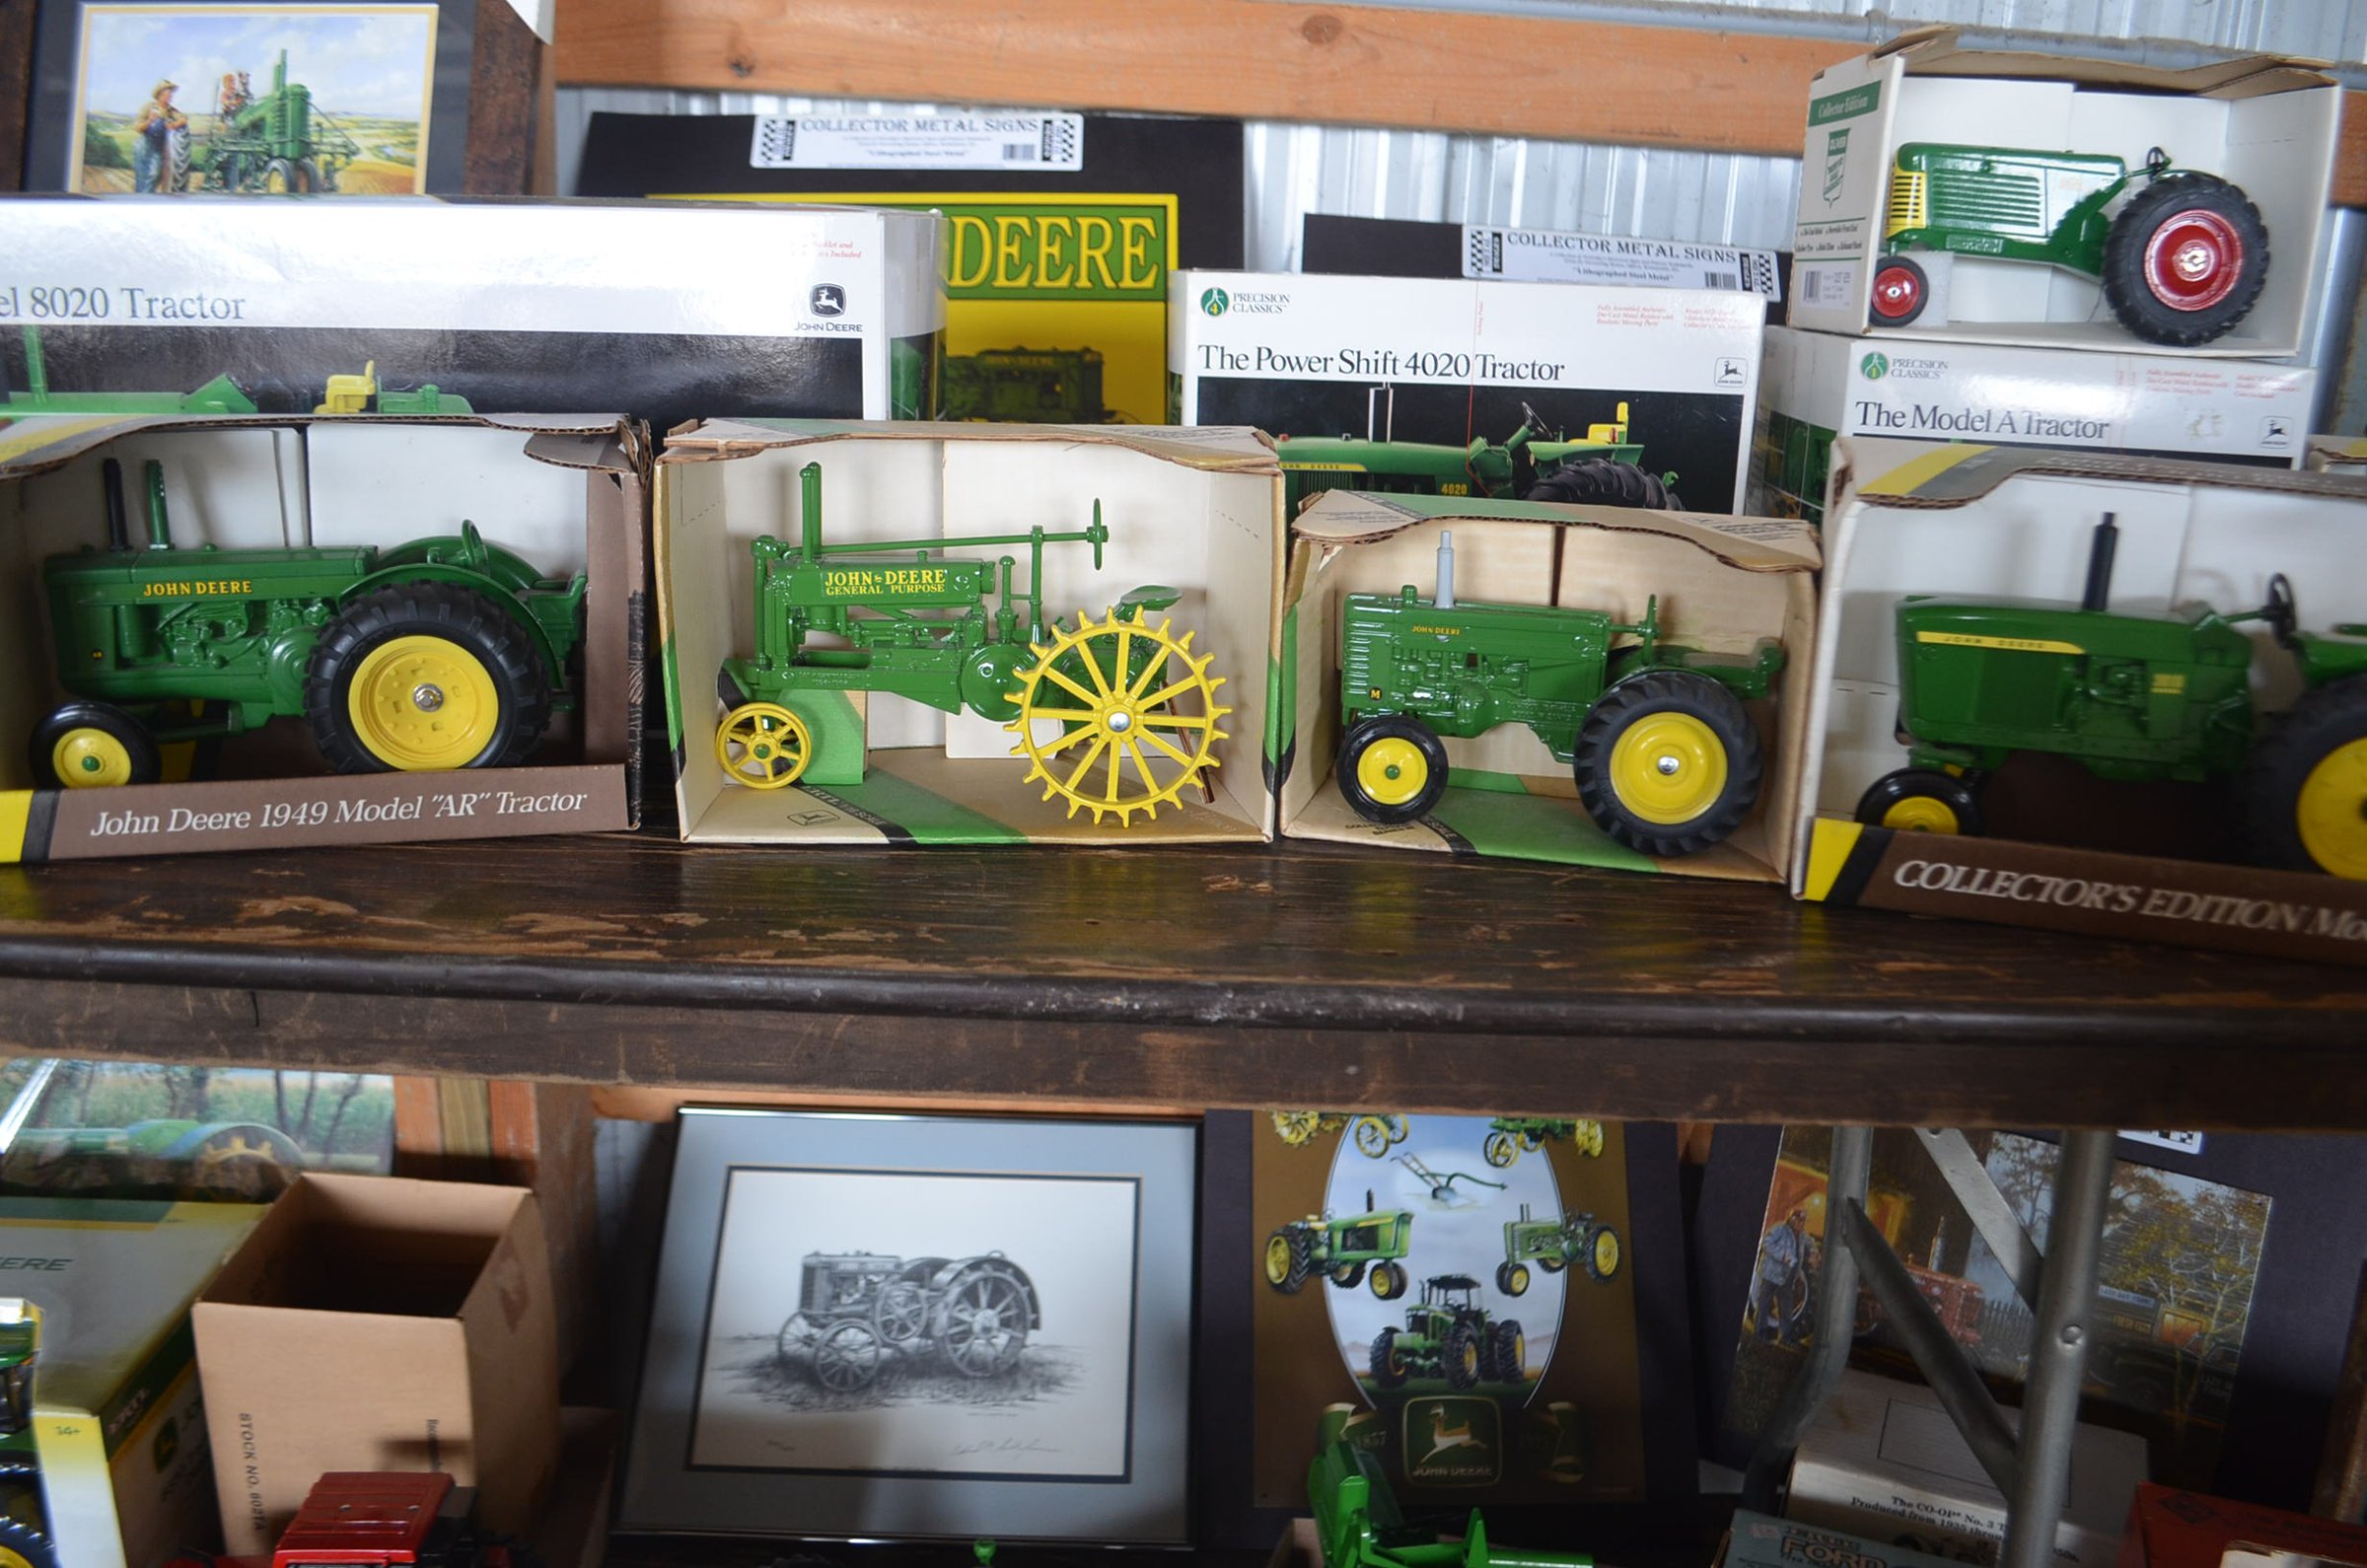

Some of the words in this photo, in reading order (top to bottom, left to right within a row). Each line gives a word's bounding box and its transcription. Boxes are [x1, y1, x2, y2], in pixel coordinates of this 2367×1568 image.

[801, 118, 908, 132] COLLECTOR
[914, 118, 978, 132] METAL
[984, 117, 1039, 132] SIGNS
[947, 215, 1160, 290] DEERE
[1507, 232, 1612, 253] COLLECTOR
[1616, 241, 1681, 259] METAL
[1684, 247, 1737, 263] SIGNS
[31, 286, 109, 319] 8020
[120, 287, 246, 320] Tractor
[1233, 292, 1291, 304] PRECISION
[794, 321, 825, 331] JOHN
[825, 321, 864, 332] DEERE
[1197, 344, 1250, 371] The
[1256, 346, 1334, 374] Power
[1338, 348, 1399, 376] Shift
[1404, 351, 1470, 378] 4020
[1474, 353, 1566, 381] Tractor
[1892, 357, 1949, 371] PRECISION
[1855, 400, 1906, 429] The
[1910, 403, 1991, 433] Model
[1996, 409, 2017, 435] A
[2019, 409, 2111, 440] Tractor
[1441, 482, 1468, 496] 4020
[143, 582, 192, 598] JOHN
[195, 580, 253, 596] DEERE
[825, 571, 873, 587] JOHN
[884, 568, 946, 585] DEERE
[825, 584, 884, 596] GENERAL
[891, 583, 946, 595] PURPOSE
[90, 809, 160, 838] John
[167, 806, 251, 833] Deere
[260, 802, 328, 827] 1949
[333, 796, 423, 824] Model
[495, 790, 588, 816] Tractor
[1893, 859, 2141, 913] COLLECTOR'S
[2140, 888, 2309, 933] EDITION
[0, 1256, 75, 1272] ERE
[239, 1412, 257, 1461] STOCK
[245, 1465, 260, 1489] NO.
[1850, 1495, 1906, 1519] Produced
[1907, 1510, 1936, 1526] from
[1891, 1494, 1914, 1509] The
[1964, 1513, 1984, 1528] No.
[1986, 1520, 1995, 1530] 3
[1780, 1535, 1888, 1568] FORD
